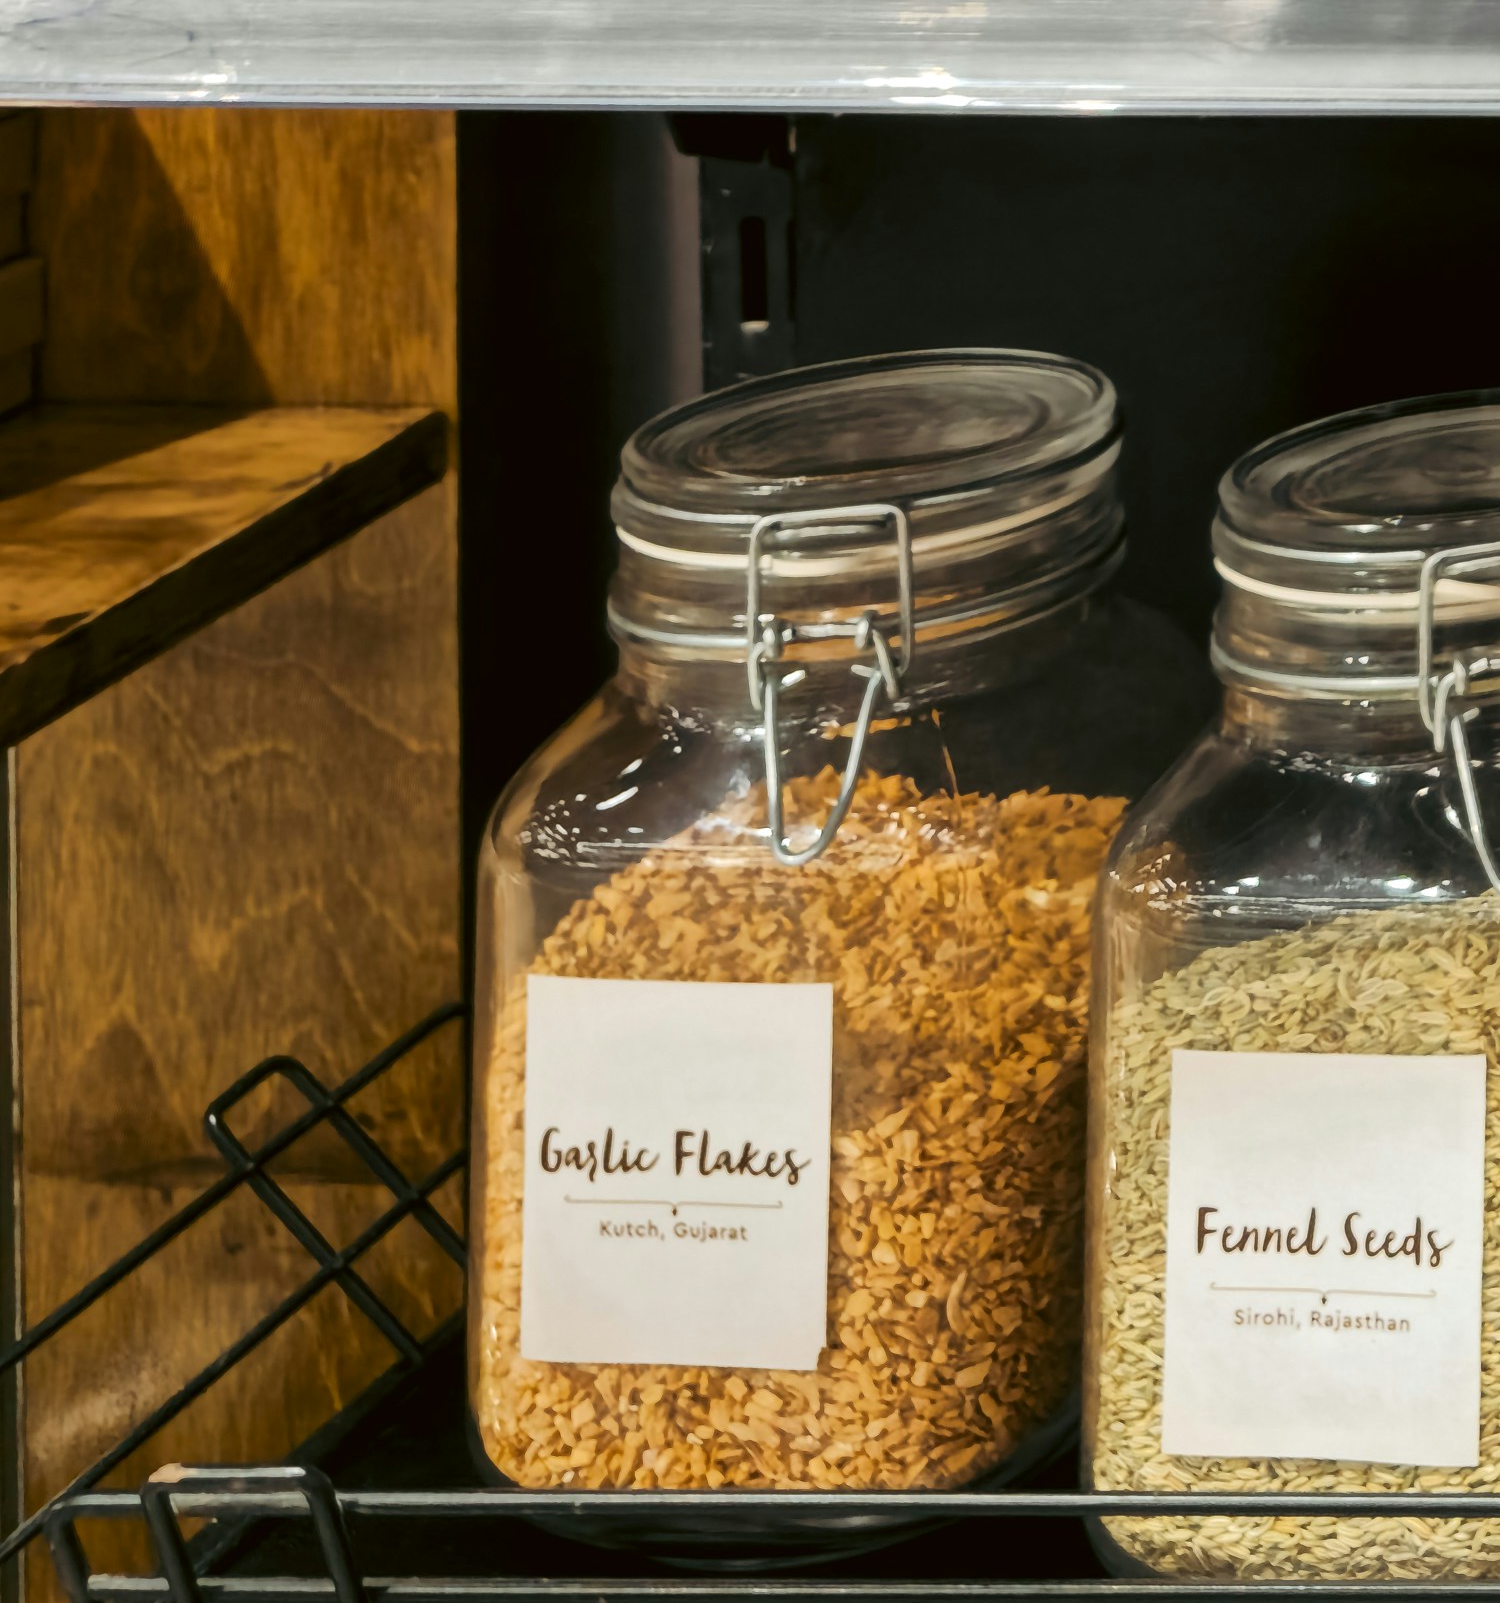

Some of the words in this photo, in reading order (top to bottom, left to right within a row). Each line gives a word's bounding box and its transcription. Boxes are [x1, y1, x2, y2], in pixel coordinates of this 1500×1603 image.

[541, 1127, 660, 1183] Garlic
[674, 1129, 811, 1186] Flakes
[599, 1219, 665, 1242] Kutch,
[673, 1221, 748, 1243] Gujarat
[1197, 1207, 1328, 1255] Fennel
[1342, 1212, 1454, 1267] Seeds
[1233, 1307, 1301, 1330] Sirohi,
[1310, 1310, 1410, 1332] Rajasthan
